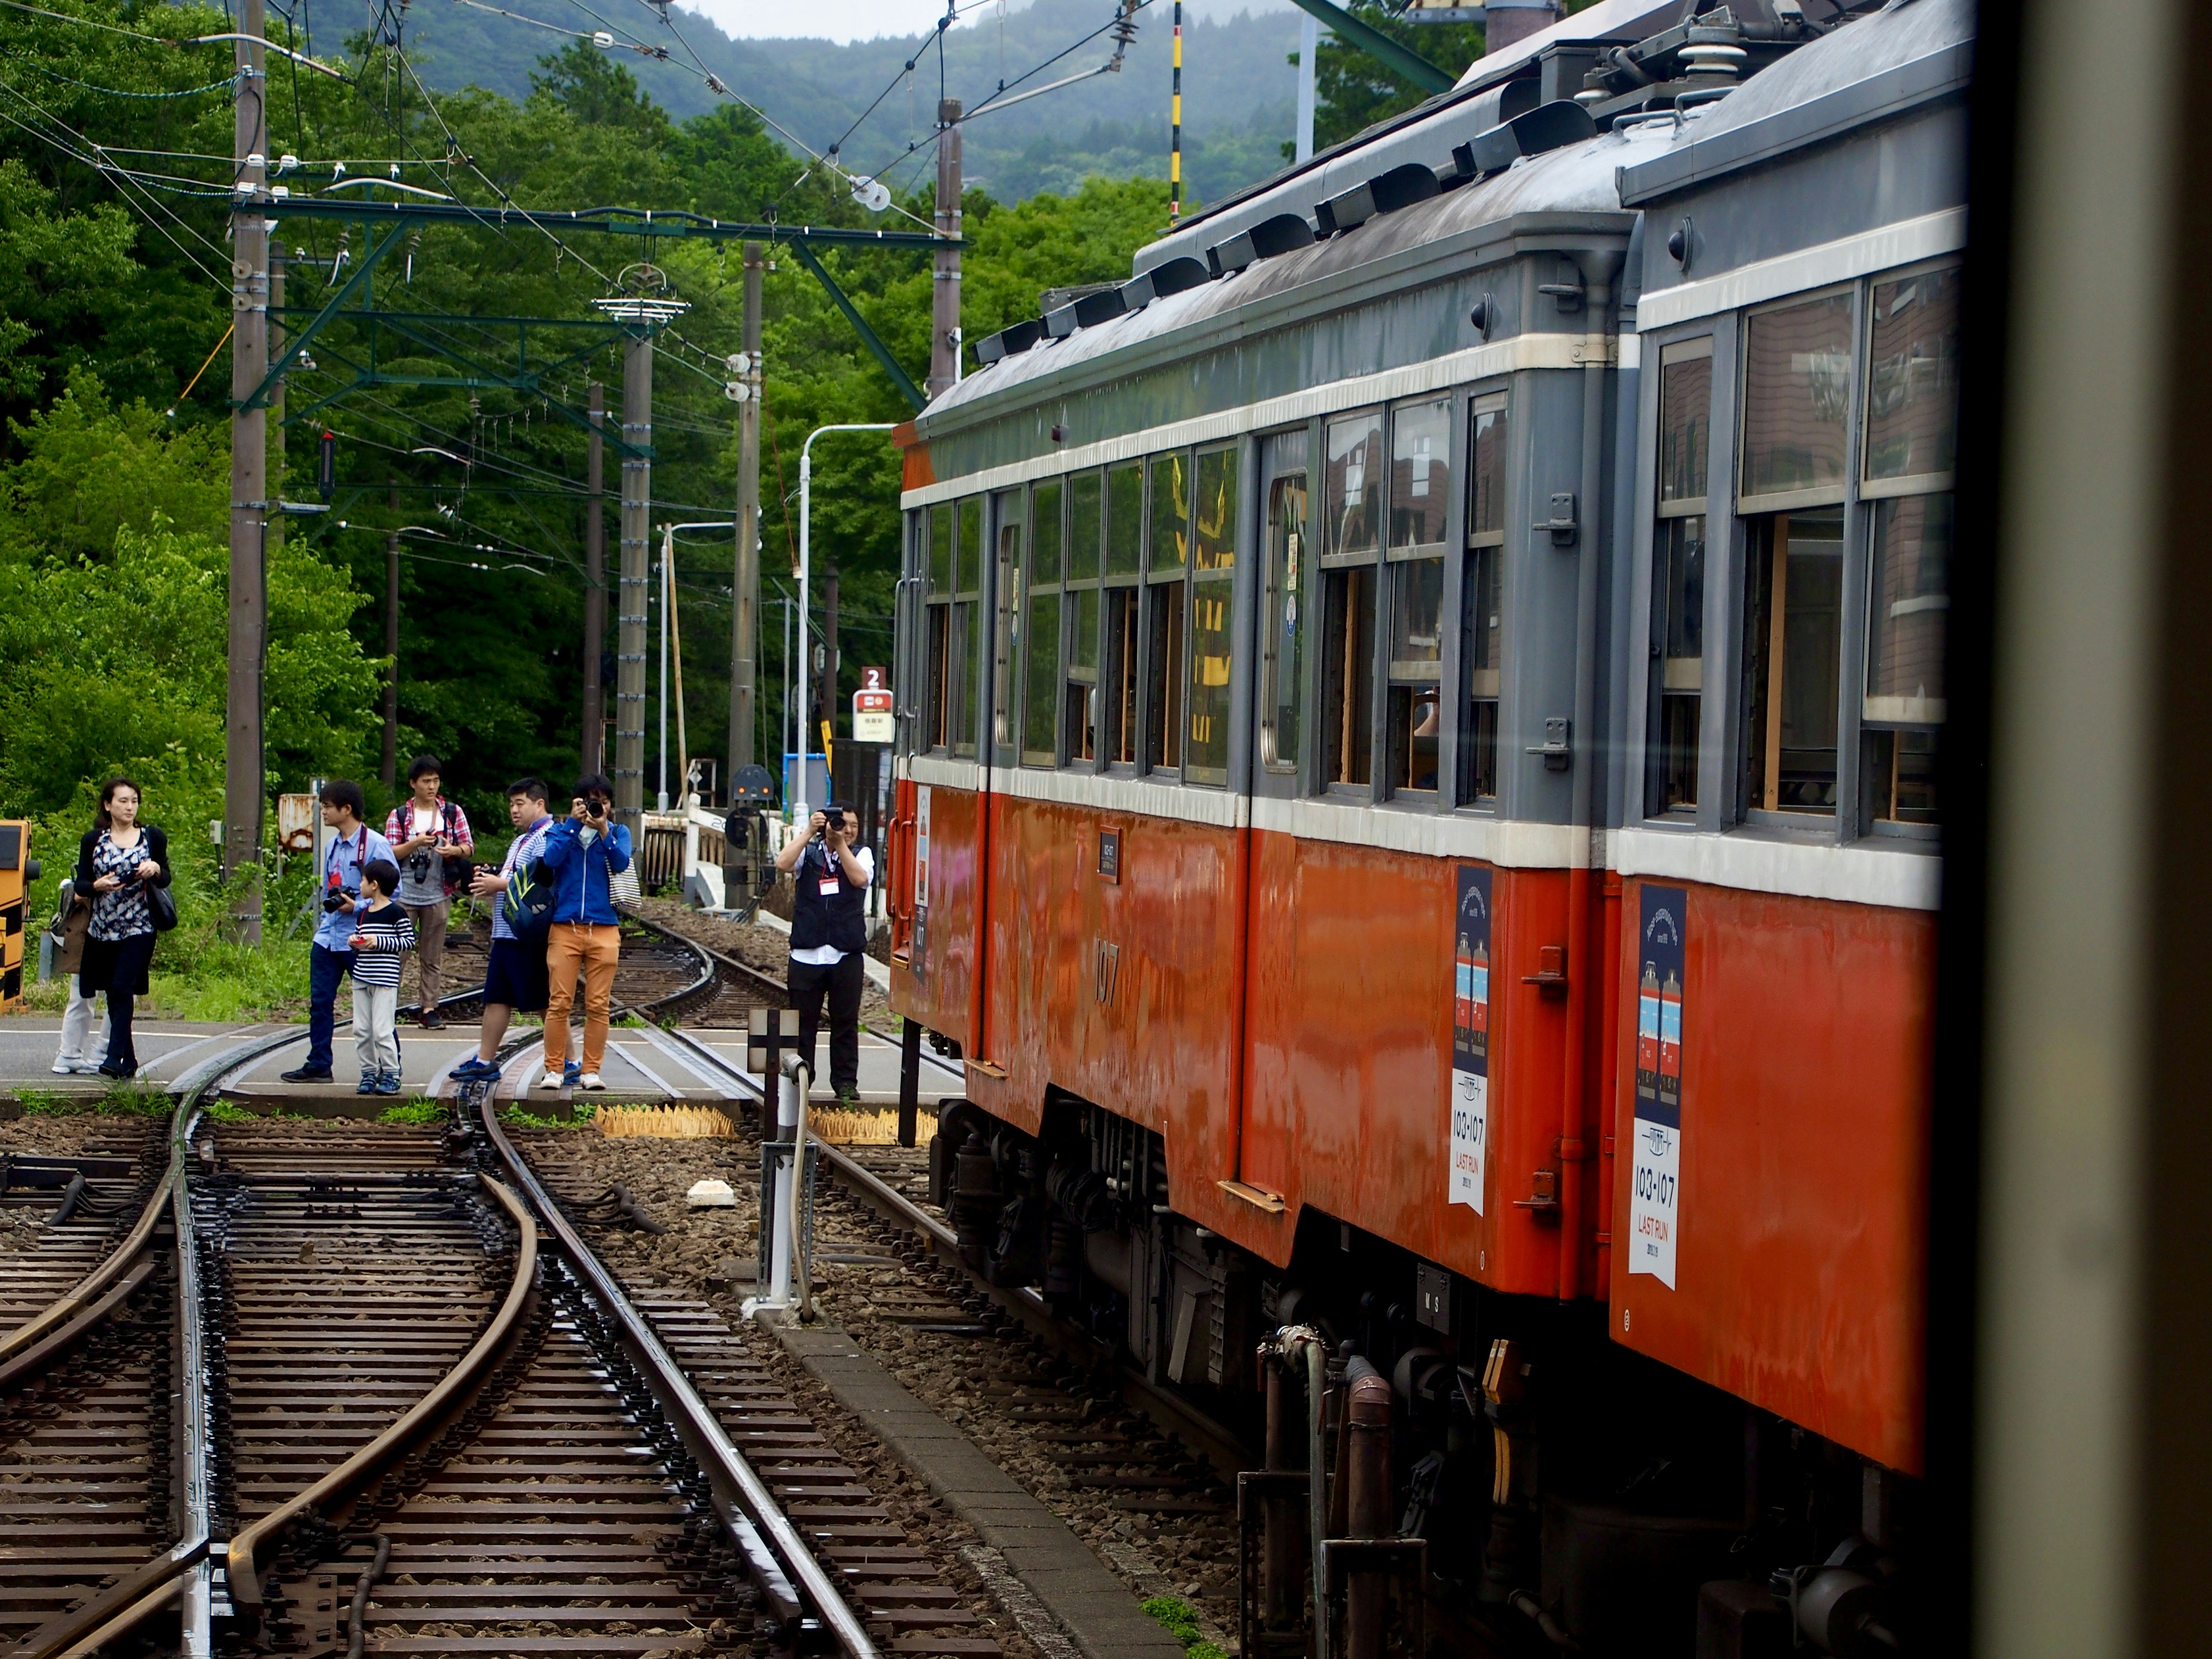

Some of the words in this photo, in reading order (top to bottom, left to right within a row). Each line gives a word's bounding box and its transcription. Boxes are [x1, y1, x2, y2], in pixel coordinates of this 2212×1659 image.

[867, 670, 879, 687] 2
[1095, 938, 1119, 1007] 107
[1456, 1151, 1468, 1171] LAST
[1469, 1156, 1479, 1175] RUN
[1638, 1214, 1655, 1237] LAST
[1655, 1219, 1668, 1242] RUN
